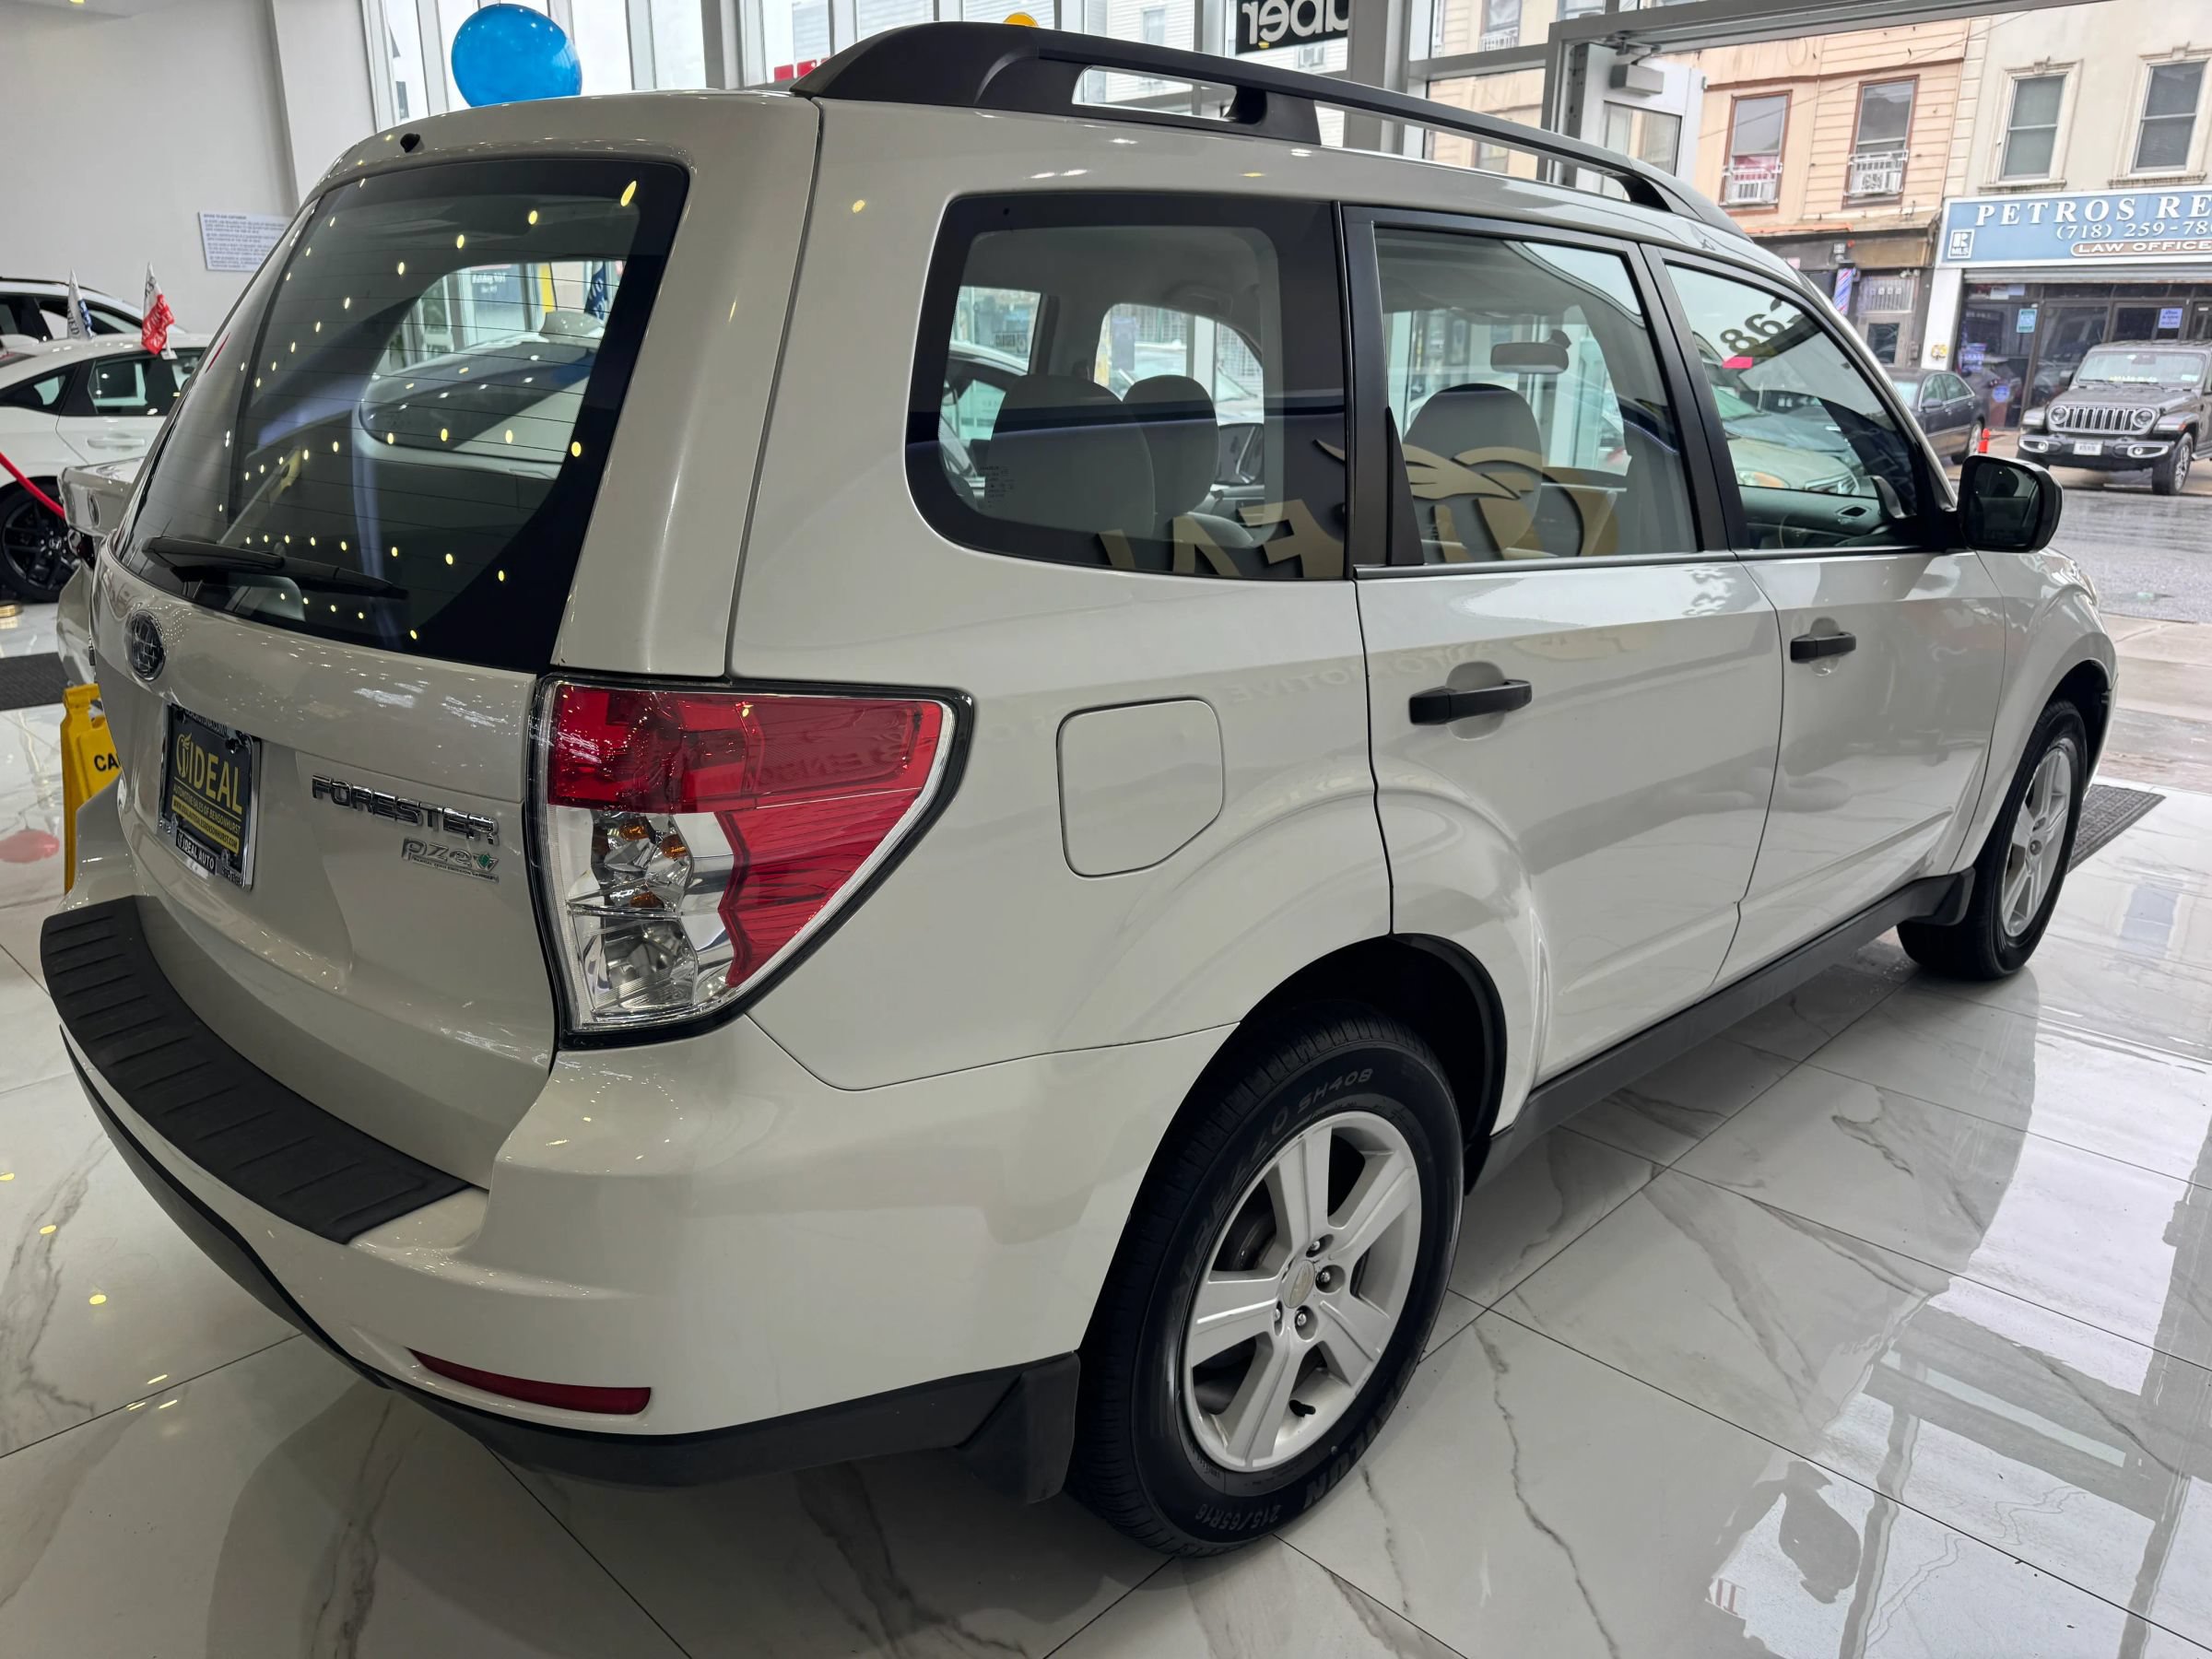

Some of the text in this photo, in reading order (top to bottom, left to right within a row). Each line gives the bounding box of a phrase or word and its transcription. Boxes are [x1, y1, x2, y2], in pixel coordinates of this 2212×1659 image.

[1975, 194, 2212, 227] PETROS RE
[2056, 220, 2212, 241] (718) 259-78
[2078, 243, 2124, 253] LAW
[93, 752, 121, 772] CA
[188, 740, 242, 815] IDEAL
[312, 773, 500, 846] FORESTER
[198, 850, 215, 870] AUTO
[1195, 1503, 1283, 1531] 215/65R16
